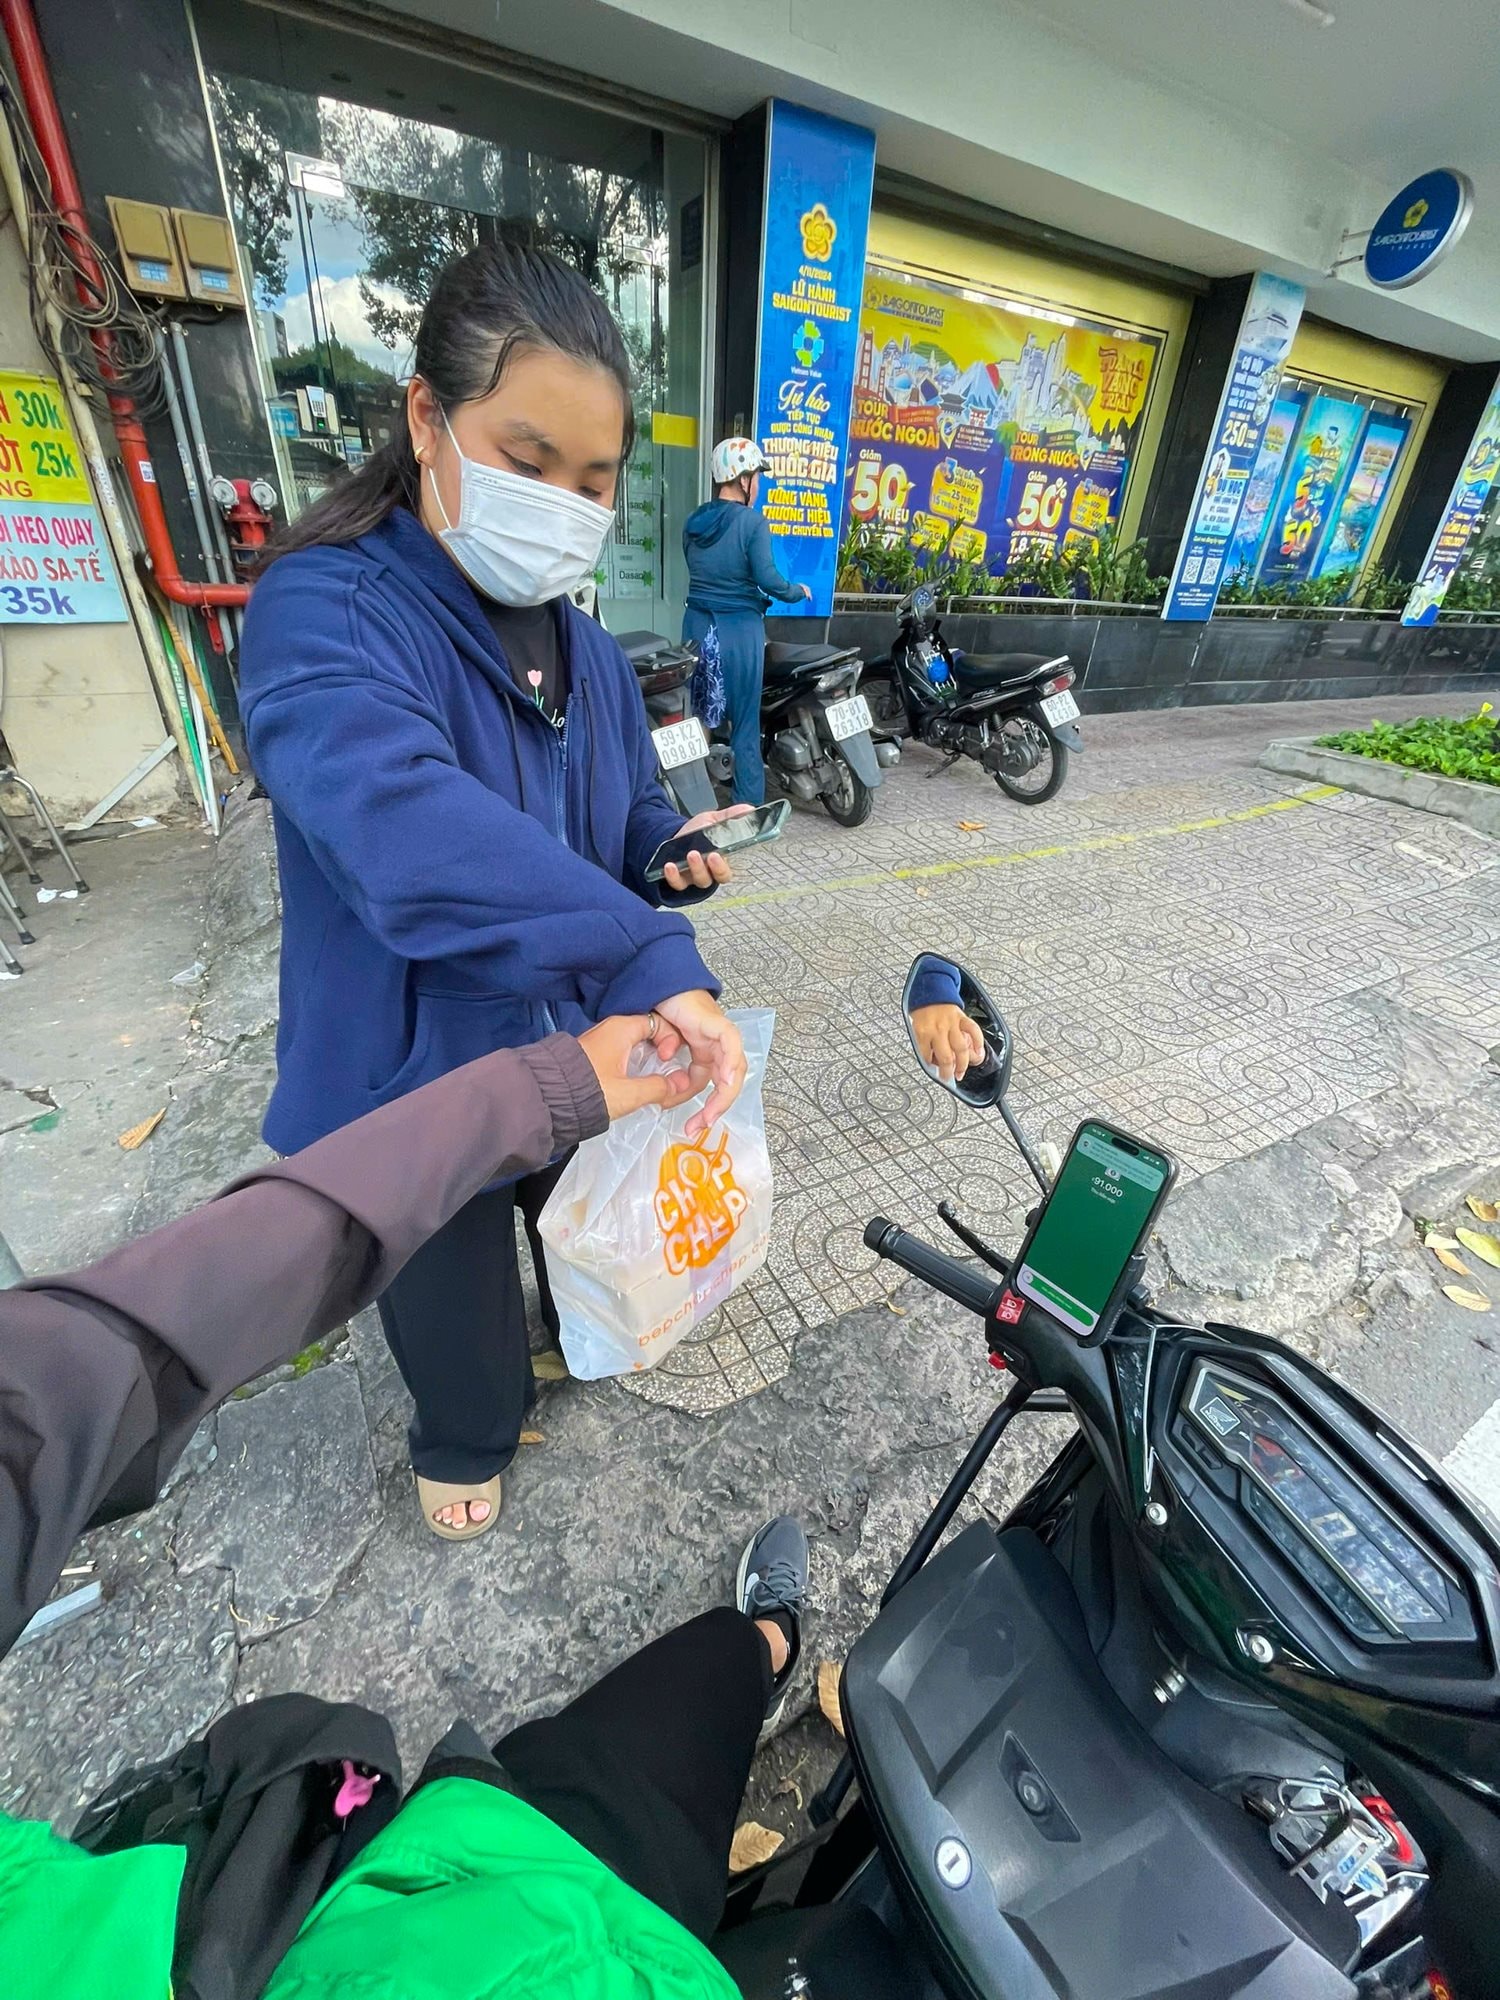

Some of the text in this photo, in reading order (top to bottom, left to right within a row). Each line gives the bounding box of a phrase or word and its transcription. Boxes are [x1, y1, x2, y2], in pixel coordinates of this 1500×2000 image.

[773, 292, 852, 322] SAIGONTOURIST
[882, 294, 945, 319] SAIGONTOURIST
[14, 389, 63, 430] 30k
[857, 400, 889, 419] TOUR
[850, 416, 893, 440] NƯỚC
[894, 424, 940, 449] NGOÀI
[1016, 431, 1039, 445] TOUR
[1221, 419, 1248, 447] 250
[31, 440, 77, 478] 25k
[860, 449, 882, 461] Giảm
[1011, 445, 1047, 463] TRONG
[1048, 449, 1080, 469] NƯỚC
[809, 460, 838, 485] GIA
[851, 460, 908, 512] 50
[878, 506, 909, 526] TRIỆU
[11, 515, 50, 545] HEO
[51, 516, 95, 550] QUAY
[1280, 519, 1313, 555] 50
[43, 548, 105, 582] SA-TẾ
[0, 586, 77, 615] 35k
[660, 723, 696, 747] 59-K2
[834, 713, 869, 737] 263.18
[662, 738, 702, 765] 098.87
